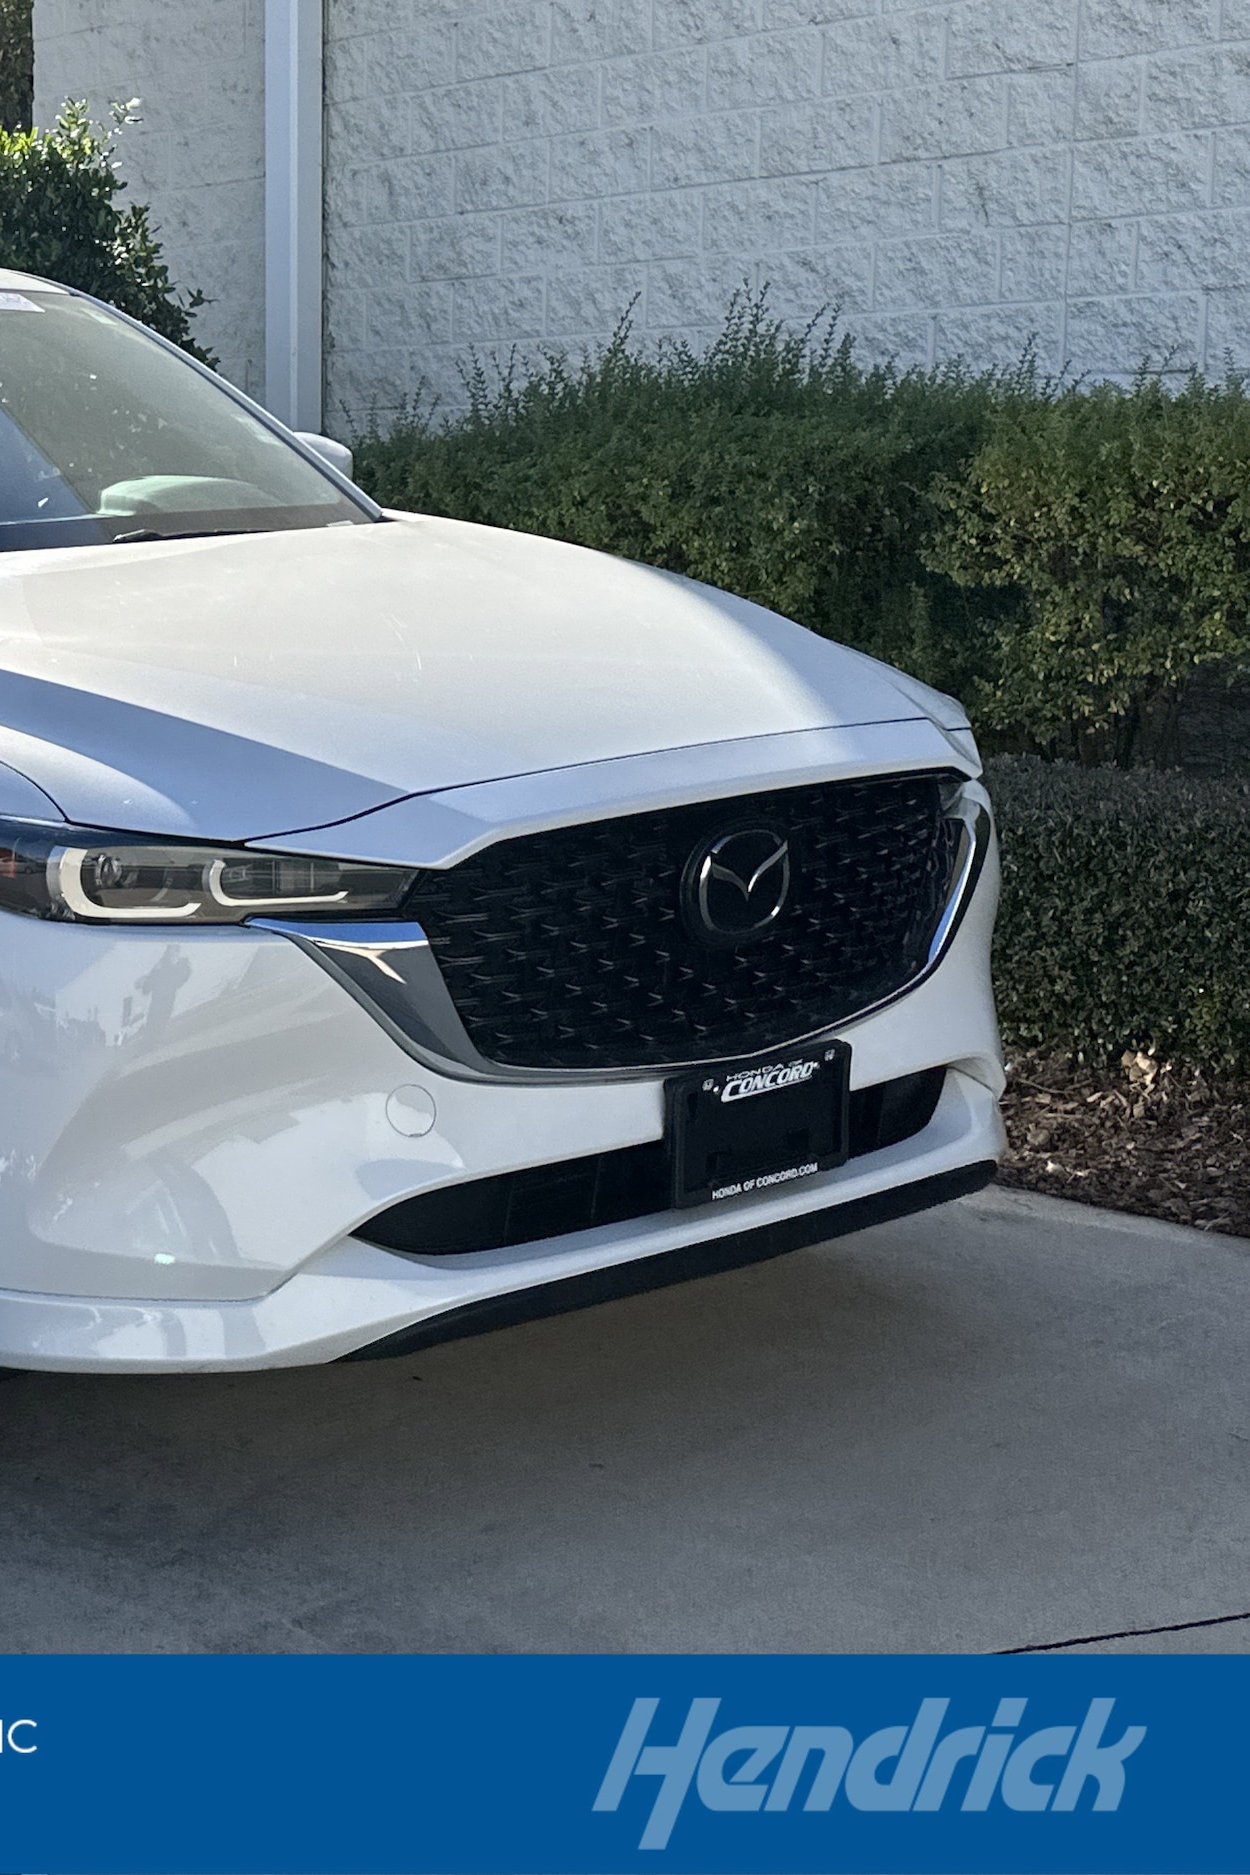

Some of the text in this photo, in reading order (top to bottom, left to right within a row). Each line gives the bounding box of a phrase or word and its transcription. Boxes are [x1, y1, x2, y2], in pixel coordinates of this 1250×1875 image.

[720, 1061, 815, 1103] CONCORD
[726, 1063, 784, 1082] HONDA
[711, 1162, 818, 1200] HONDA OF CONCORD.COM
